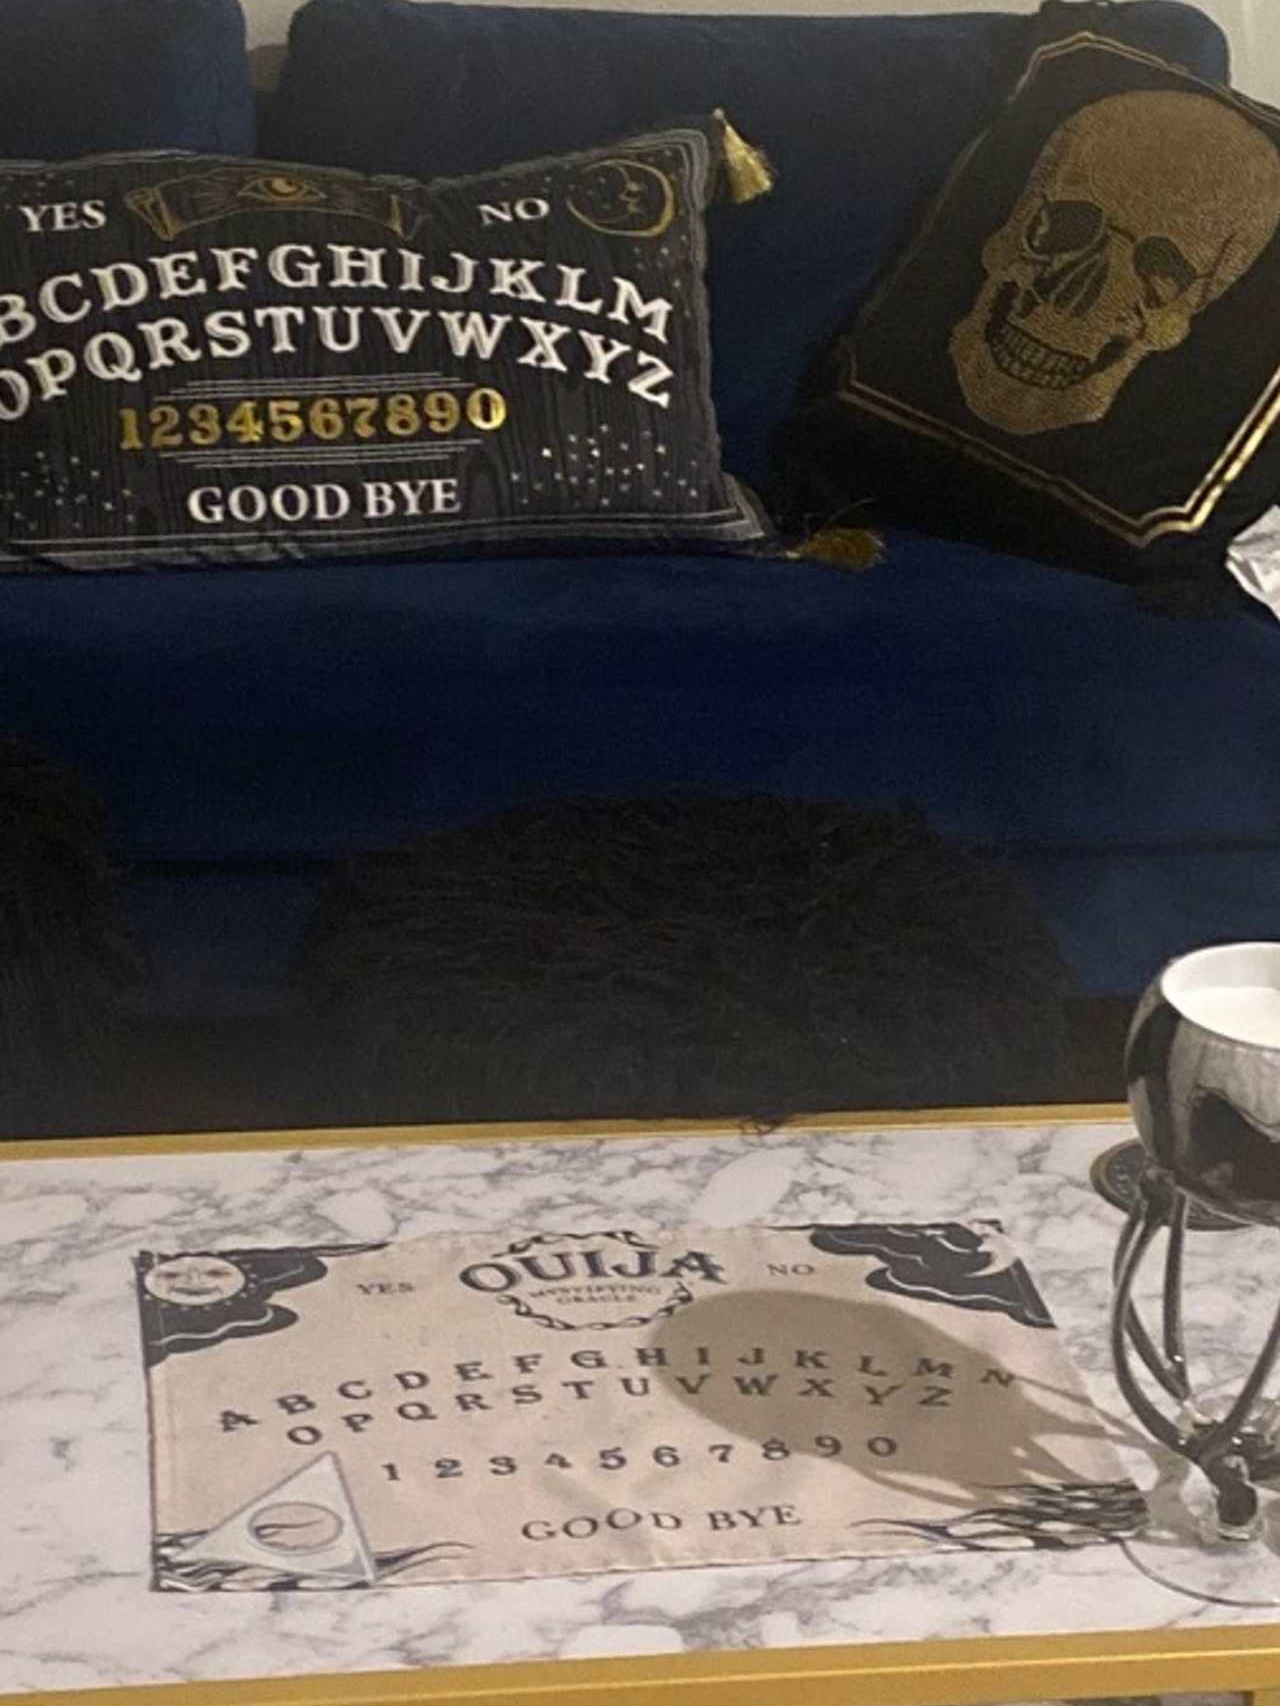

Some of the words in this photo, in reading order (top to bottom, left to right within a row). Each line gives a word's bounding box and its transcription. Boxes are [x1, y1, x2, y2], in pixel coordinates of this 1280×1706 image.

[20, 199, 107, 233] YES
[476, 197, 551, 227] NO
[120, 387, 508, 451] 1234567890
[187, 483, 351, 524] GOOD
[362, 478, 462, 519] BYE
[458, 1250, 729, 1293] OUIJA
[766, 1263, 816, 1277] NO
[356, 1280, 416, 1297] YES
[520, 1508, 684, 1542] GOOD
[706, 1504, 803, 1532] BYE
